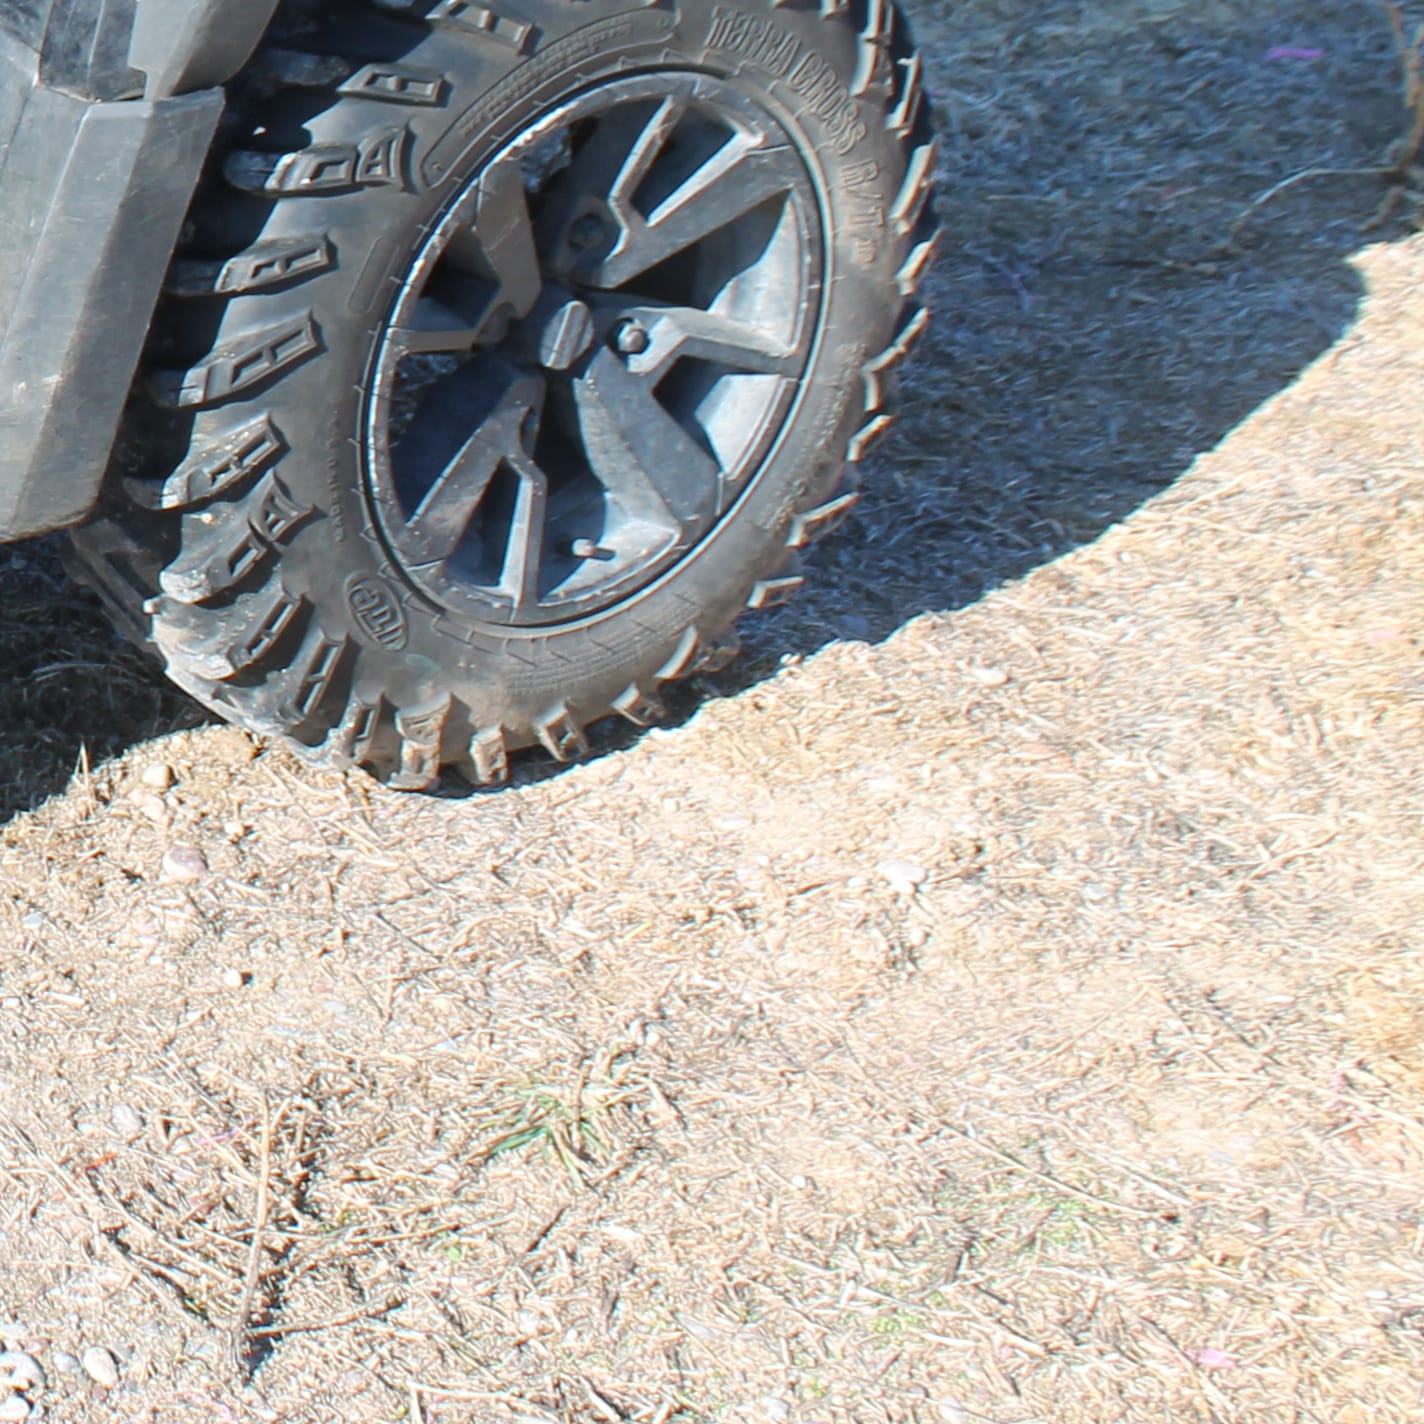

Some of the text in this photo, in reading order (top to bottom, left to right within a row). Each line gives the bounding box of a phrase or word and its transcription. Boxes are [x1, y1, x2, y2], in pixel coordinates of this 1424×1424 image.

[703, 4, 802, 77] TERRA
[788, 49, 867, 156] CROSS
[349, 580, 407, 650] ITP
